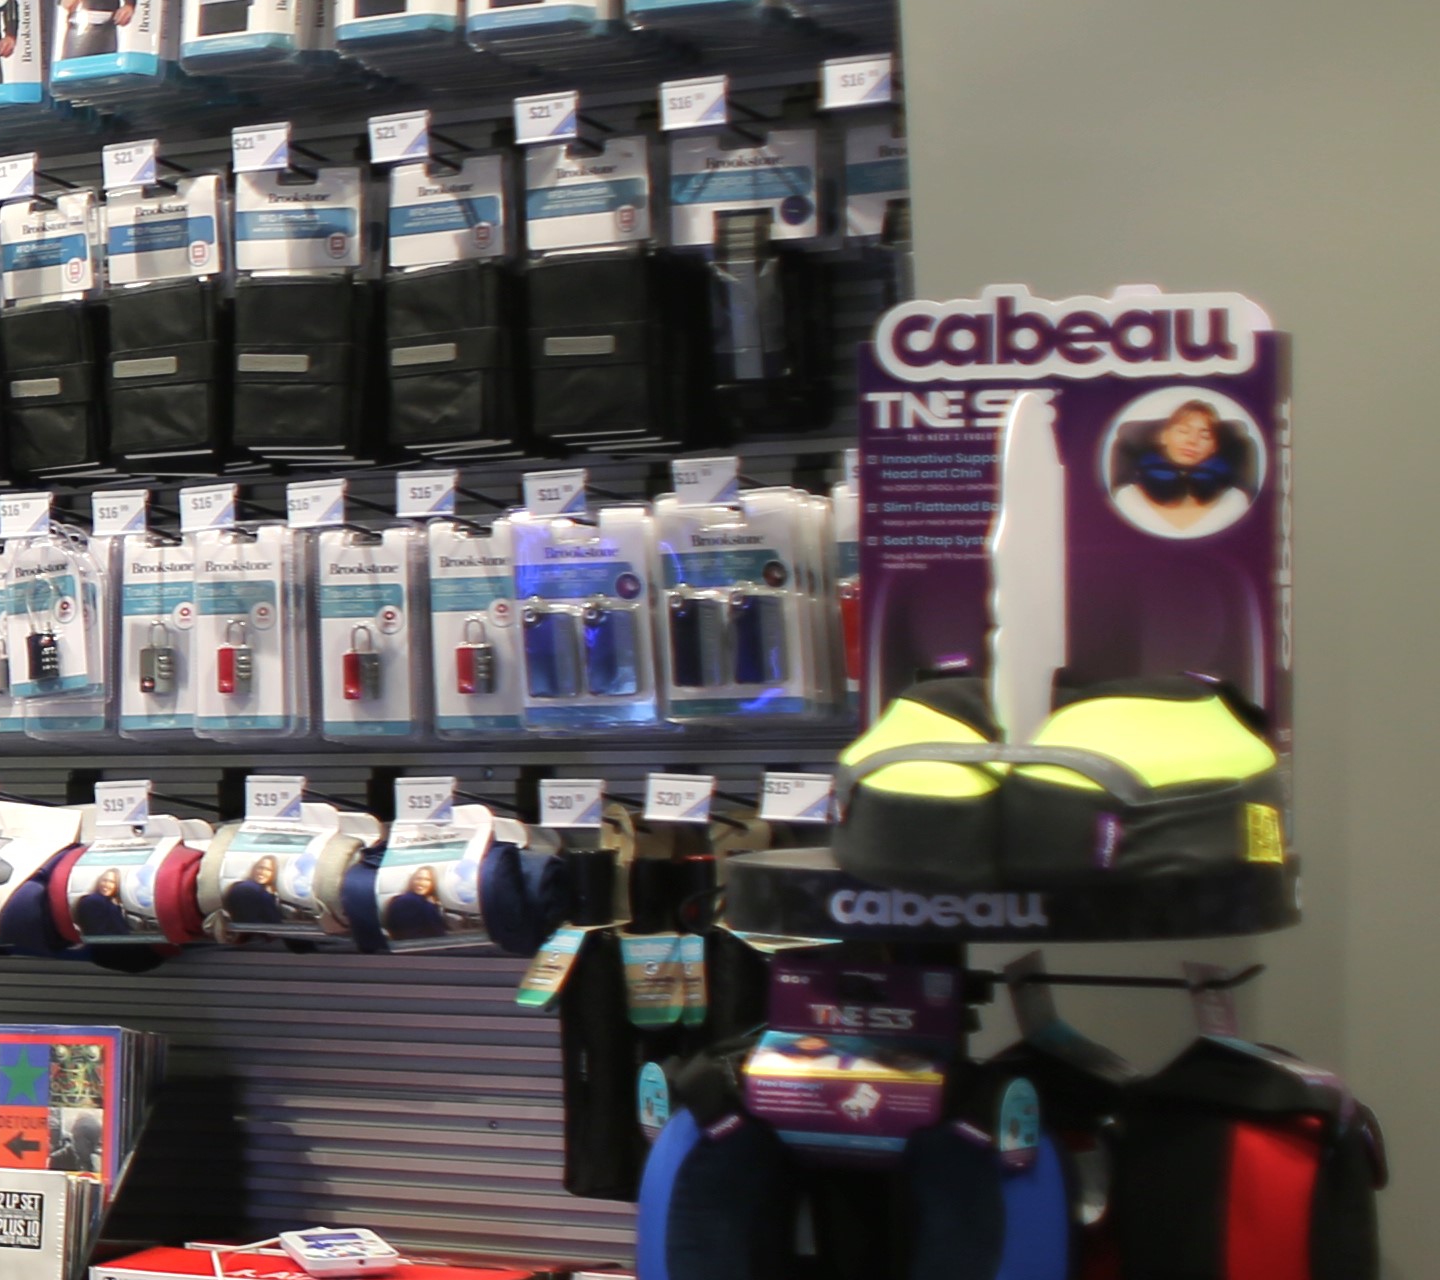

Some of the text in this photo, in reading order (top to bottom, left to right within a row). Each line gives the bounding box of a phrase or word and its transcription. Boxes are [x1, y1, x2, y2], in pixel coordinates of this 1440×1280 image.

[891, 296, 1236, 365] cabeau
[6, 1193, 18, 1209] LP
[19, 1195, 40, 1210] SET
